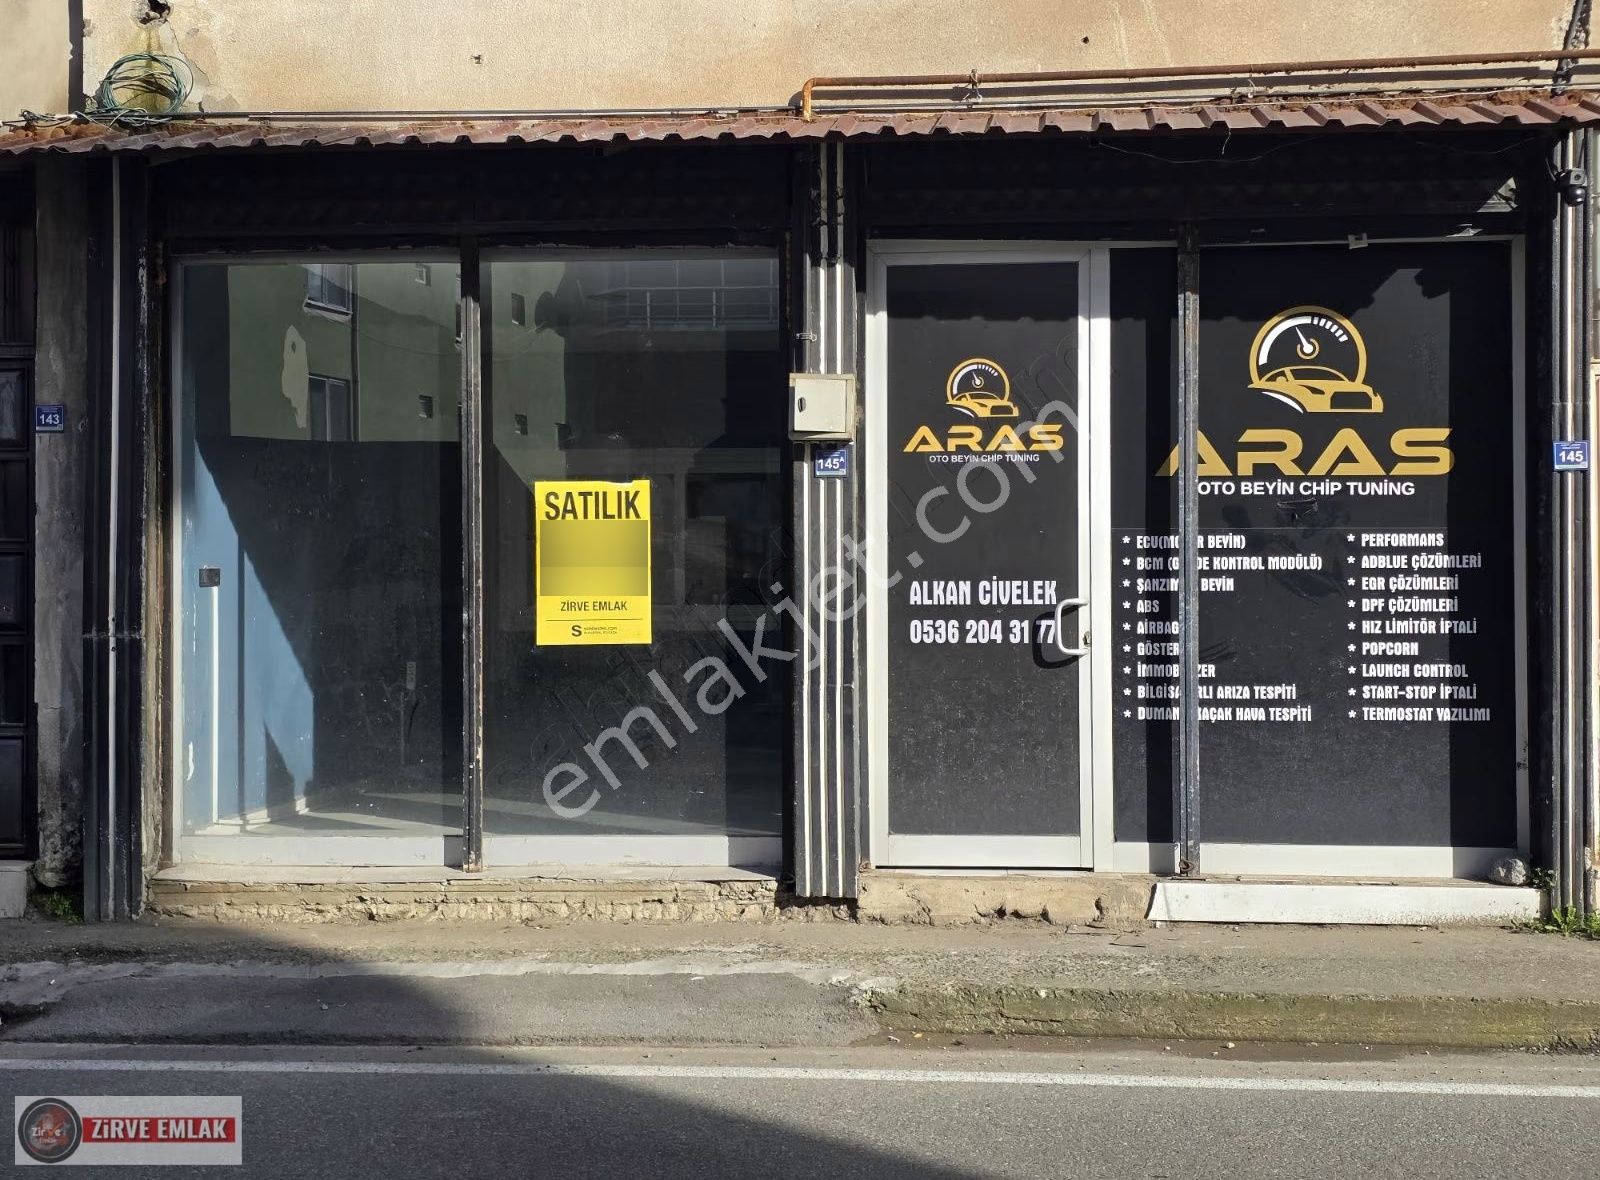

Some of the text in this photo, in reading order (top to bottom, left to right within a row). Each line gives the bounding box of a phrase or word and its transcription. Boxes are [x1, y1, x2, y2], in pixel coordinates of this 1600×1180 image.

[40, 414, 60, 424] 143
[903, 424, 1064, 453] ARAS
[929, 453, 1040, 463] OTO BEYİN CHİP TUNİNG
[1155, 427, 1455, 476] ARAS
[1559, 451, 1584, 462] 145
[1197, 478, 1415, 496] OTO BEYİN CHİP TUNİNG
[544, 490, 641, 521] SATILIK
[1208, 533, 1246, 550] BEYİN)
[1361, 533, 1444, 547] PERFORMANS
[1137, 554, 1322, 571] BCM (GDE KONTROL MODÜLÜ)
[1361, 553, 1482, 570] ADBLUE ÇÖZÜMLERİ
[909, 575, 1057, 605] ALKAN CİVELEK
[1201, 576, 1234, 591] BEYİN
[1362, 574, 1459, 592] EGR ÇÖZÜMLERİ
[560, 600, 627, 611] ZİRVE EMLAK
[1136, 600, 1160, 612] ABS
[1362, 596, 1459, 614] DPF ÇÖZÜMLERİ
[910, 620, 959, 644] 0536
[965, 620, 1003, 644] 204
[1009, 620, 1029, 644] 31
[1362, 618, 1477, 634] HIZ LİMİTÖR İPTALİ
[1362, 642, 1419, 655] POPCORN
[1362, 664, 1468, 677] LAUNCH CONTROL
[1217, 686, 1250, 699] ARIZA
[1254, 684, 1297, 699] TESPİTİ
[1362, 683, 1477, 699] START-STOP İPTALİ
[1236, 707, 1265, 721] HAVA
[1269, 705, 1312, 721] TESPİTİ
[1362, 707, 1490, 721] TERMOSTAT YAZILIMI
